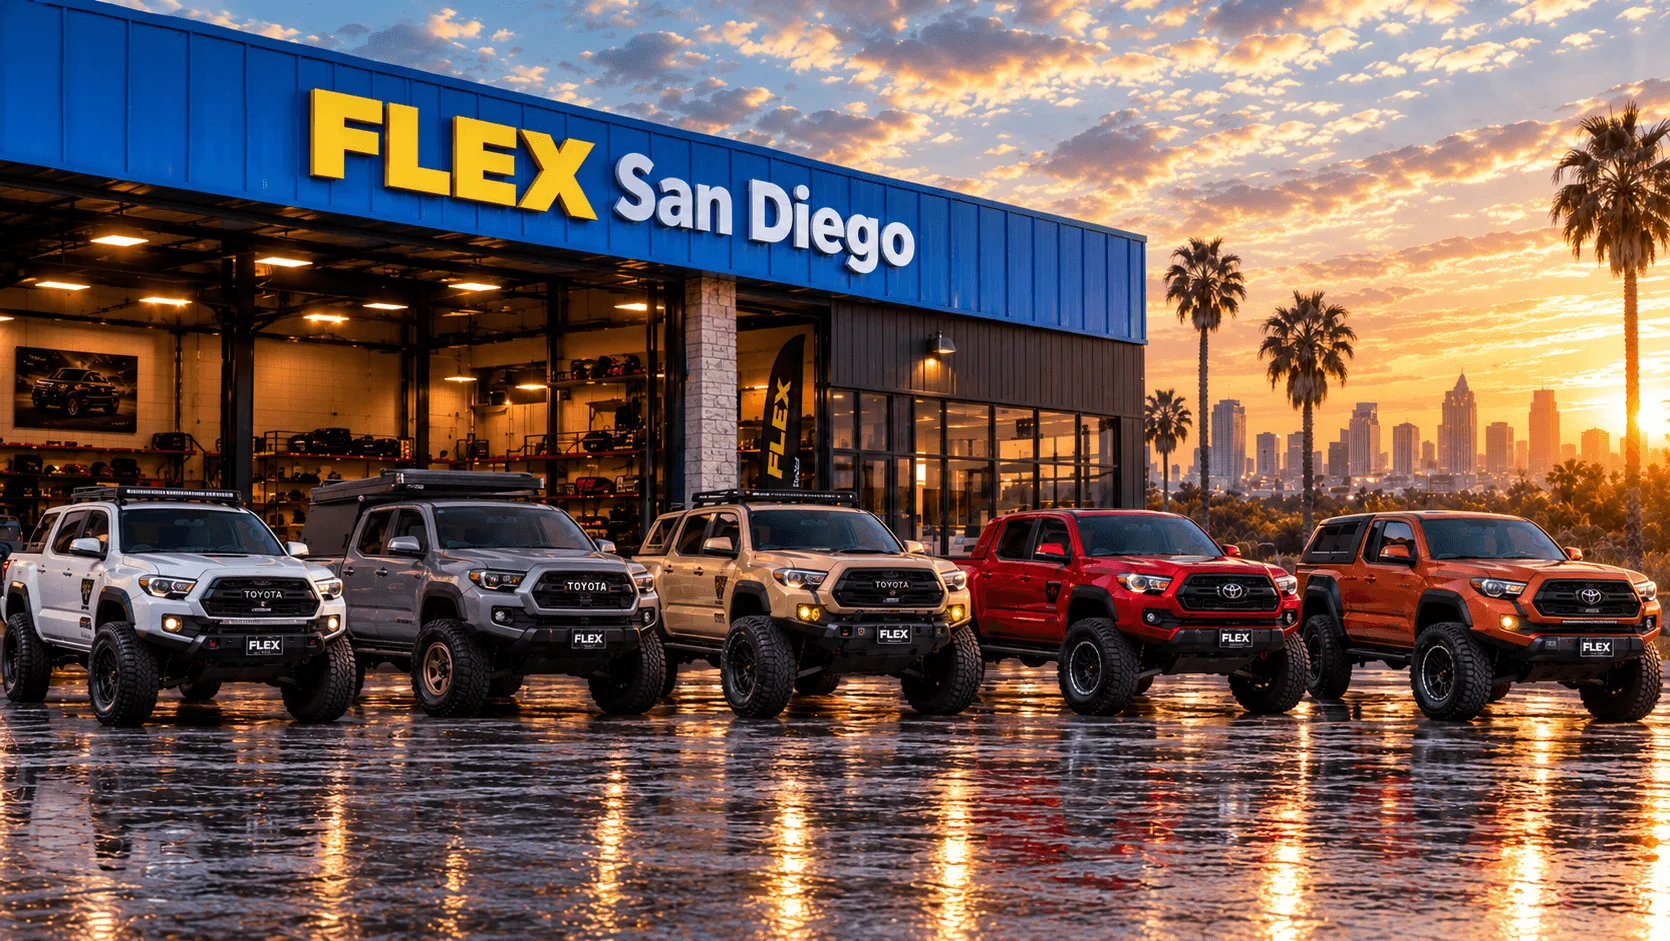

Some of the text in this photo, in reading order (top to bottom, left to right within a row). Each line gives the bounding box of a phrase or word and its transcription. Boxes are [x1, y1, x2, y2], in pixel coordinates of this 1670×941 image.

[309, 88, 915, 274] FLEX San Diego
[767, 377, 791, 480] FLEX
[567, 581, 607, 591] TOYOTA
[875, 580, 909, 588] TOYOTA
[244, 590, 283, 599] TOYOTA
[574, 633, 603, 643] FLEX
[880, 629, 908, 639] FLEX
[1222, 633, 1250, 642] FLEX
[249, 640, 280, 650] FLEX
[1583, 642, 1611, 652] FLEX
